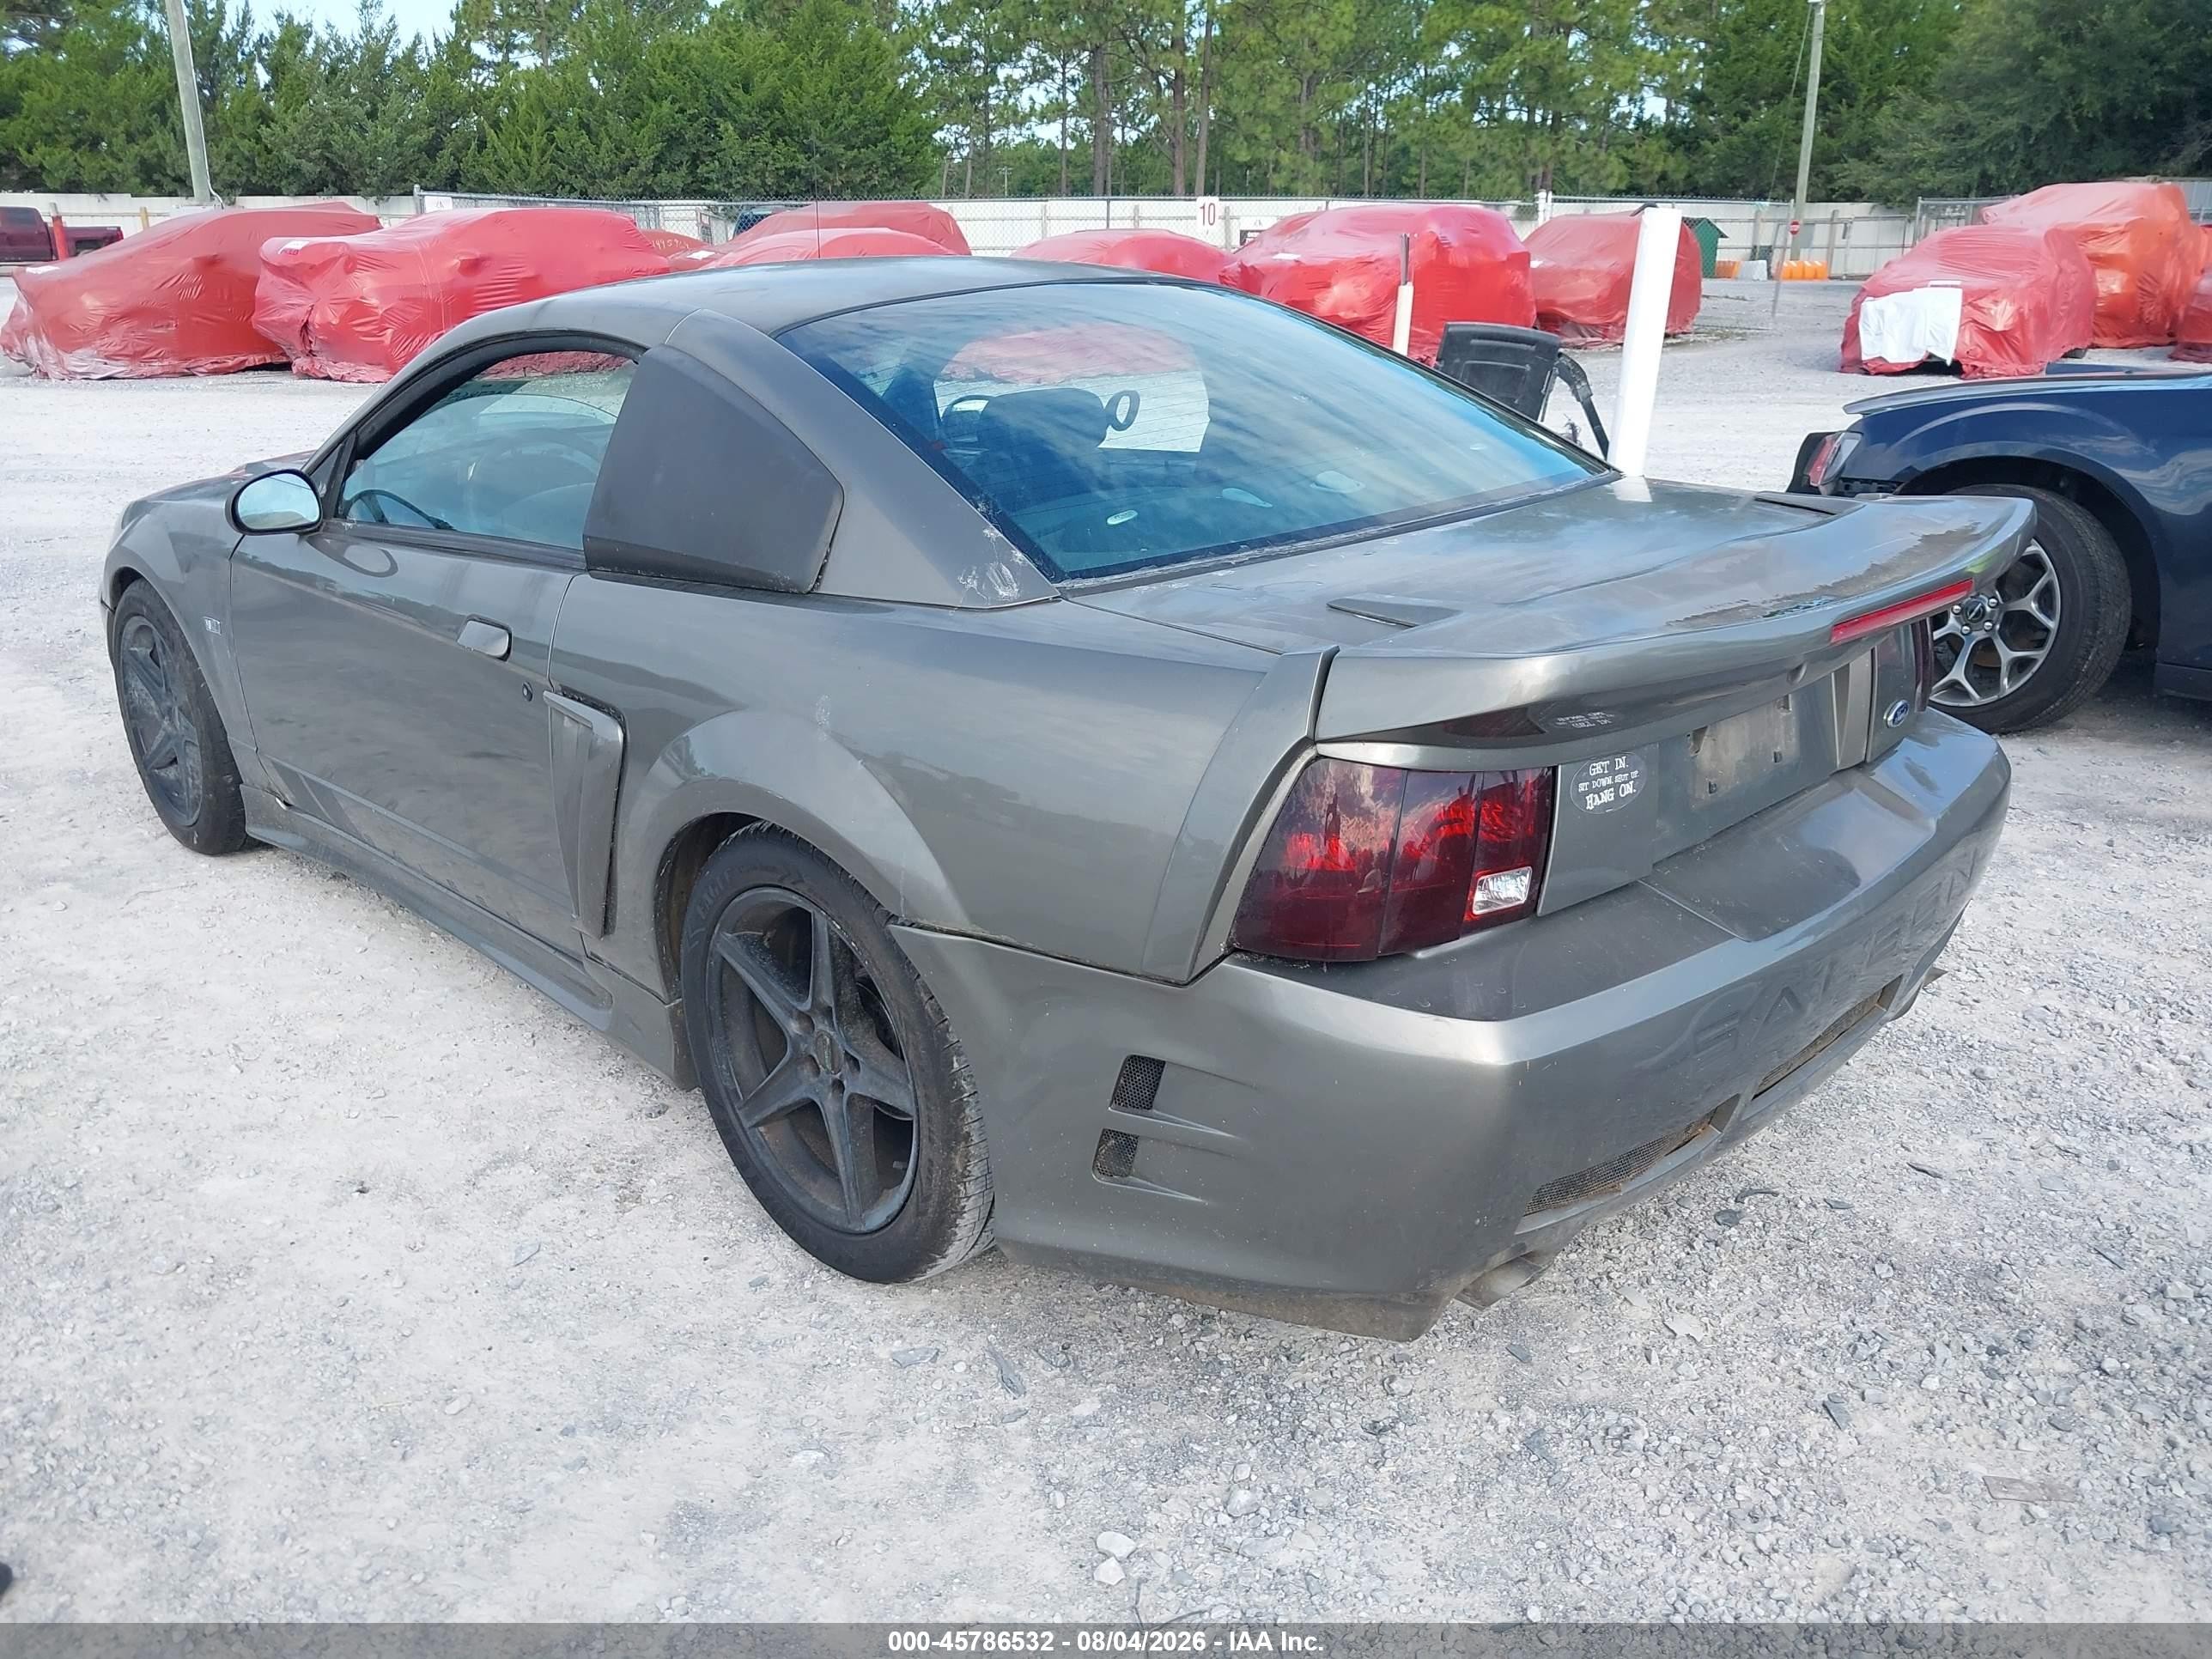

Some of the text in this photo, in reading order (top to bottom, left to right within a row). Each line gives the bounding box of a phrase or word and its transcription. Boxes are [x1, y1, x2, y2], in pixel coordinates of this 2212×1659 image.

[1200, 203, 1216, 226] 10
[1589, 756, 1629, 776] GET IN.
[1586, 781, 1637, 810] HANG ON.
